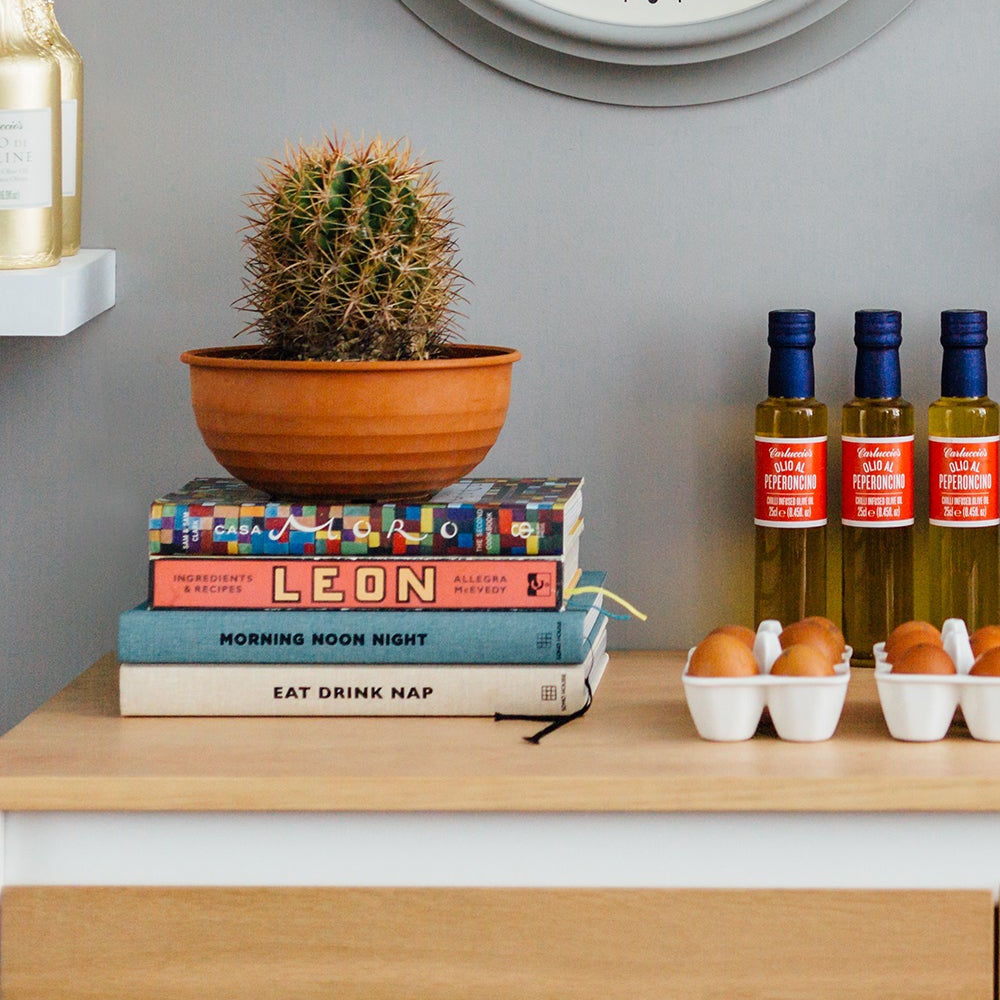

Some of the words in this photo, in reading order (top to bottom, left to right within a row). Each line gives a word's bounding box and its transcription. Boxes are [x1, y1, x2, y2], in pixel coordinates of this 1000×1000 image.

[0, 151, 32, 163] INE
[768, 447, 813, 458] Carluccio's
[857, 447, 901, 458] Carluccio's
[943, 447, 988, 458] Carluccio's
[774, 460, 793, 473] OLIO
[795, 461, 805, 473] AL
[862, 460, 882, 473] OLIO
[884, 461, 894, 473] AL
[949, 460, 968, 473] OLIO
[970, 461, 980, 473] AL
[764, 474, 817, 490] PEPERONCINO
[853, 474, 905, 490] PEPERONCINO
[939, 474, 992, 490] PEPERONCINO
[215, 525, 262, 535] CASA
[173, 574, 253, 583] INGREDIENTS
[272, 565, 436, 604] LEON
[453, 575, 508, 583] ALLEGRA
[184, 585, 191, 593] &
[194, 585, 243, 593] RECIPES
[454, 586, 507, 594] McEVEDY
[219, 633, 305, 646] MORNING
[311, 633, 365, 646] NOON
[372, 633, 428, 646] NIGHT
[273, 686, 310, 699] EAT
[319, 686, 383, 699] DRINK
[391, 686, 434, 699] NAP
